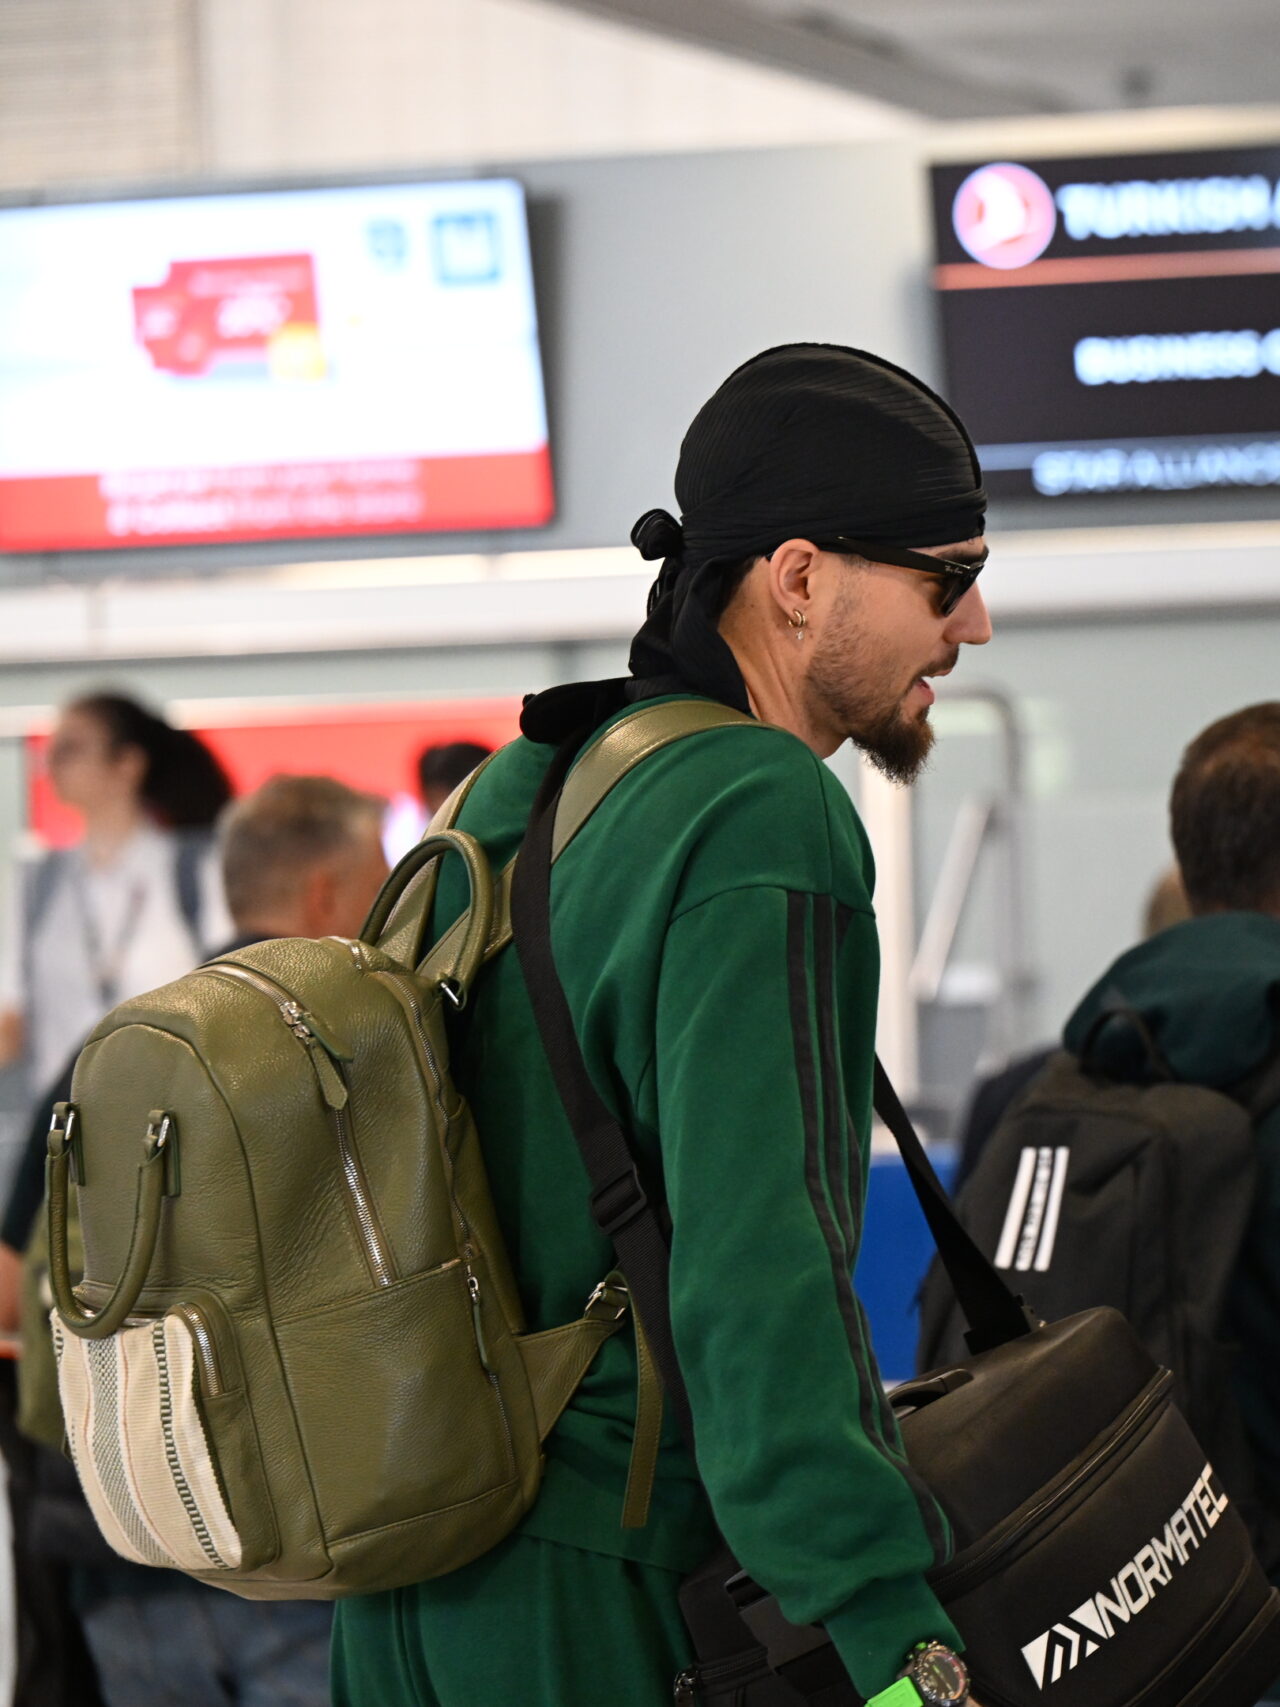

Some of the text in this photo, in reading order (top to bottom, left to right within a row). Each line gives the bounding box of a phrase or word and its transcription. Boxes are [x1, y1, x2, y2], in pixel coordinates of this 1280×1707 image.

[1056, 174, 1271, 240] TURKISH
[1075, 330, 1262, 385] BUSINESS
[1095, 1461, 1229, 1639] NORMATEC
